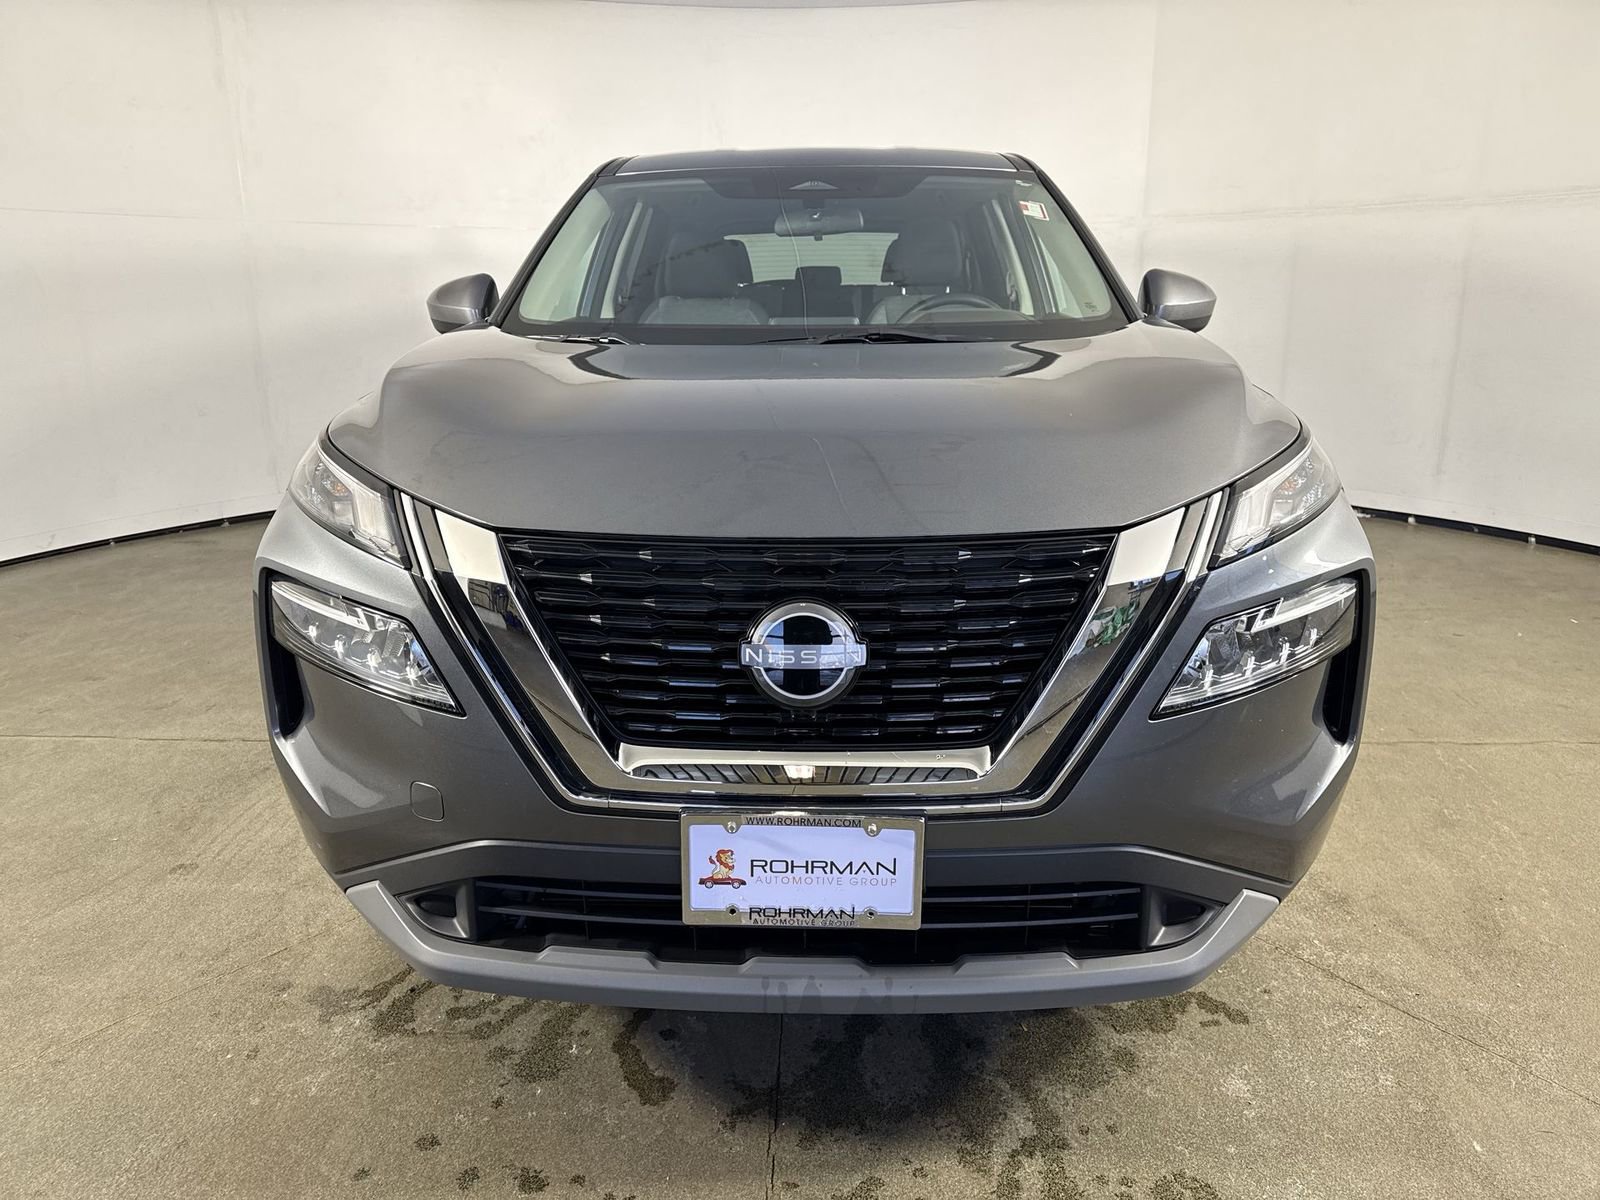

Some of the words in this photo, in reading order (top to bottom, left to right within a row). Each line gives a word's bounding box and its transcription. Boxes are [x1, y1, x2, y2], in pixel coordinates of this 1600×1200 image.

[745, 816, 862, 828] WWW.ROHRMAN.COM
[750, 858, 897, 877] ROHRMAN
[755, 876, 843, 886] AUTOMOTIVE
[849, 877, 897, 887] GROUP
[749, 907, 855, 920] ROHRMAN
[752, 918, 816, 926] AUTOMOTIVE
[820, 919, 855, 927] GROUP
